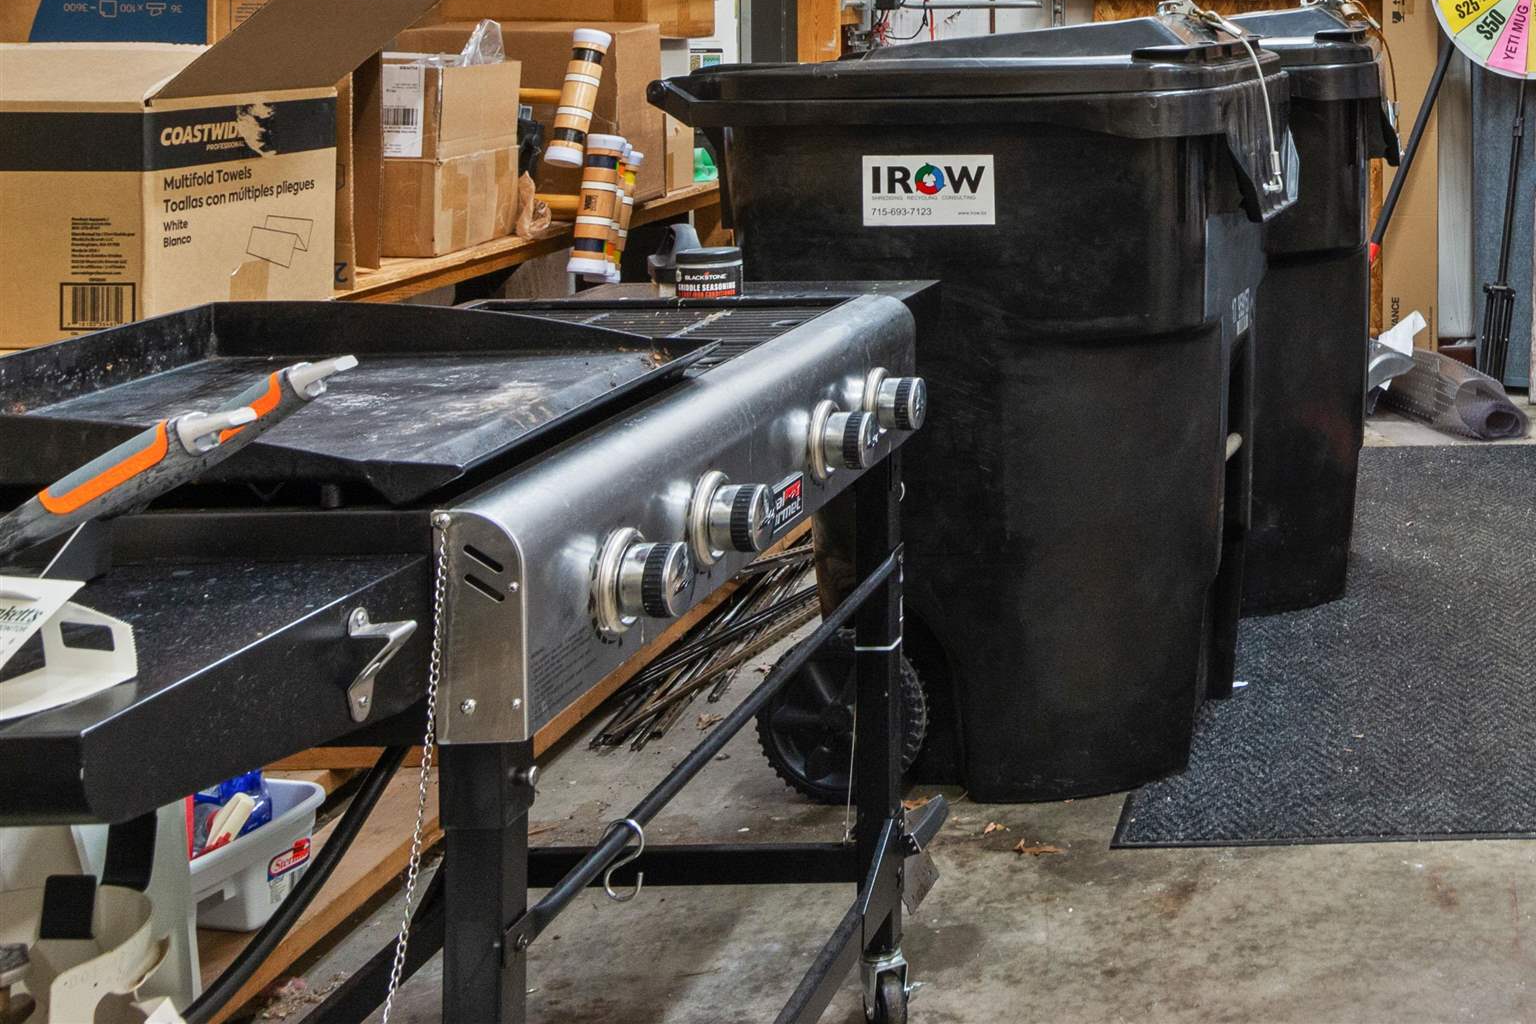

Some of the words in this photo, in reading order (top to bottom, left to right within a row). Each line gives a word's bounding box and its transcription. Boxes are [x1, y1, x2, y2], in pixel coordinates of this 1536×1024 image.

[1476, 8, 1506, 41] $50
[1511, 5, 1529, 34] MUG
[1503, 35, 1521, 60] YETI
[160, 120, 243, 147] COASTWID
[164, 171, 214, 191] Multifold
[216, 165, 252, 184] Towels
[871, 162, 986, 196] IROW
[163, 196, 204, 214] Toallas
[205, 192, 226, 207] con
[228, 183, 274, 203] múltiples
[276, 179, 315, 197] pliegues
[871, 207, 932, 217] 715-693-7123
[163, 219, 189, 232] White
[163, 234, 192, 248] Blanco
[684, 271, 728, 281] BLACKSTONE
